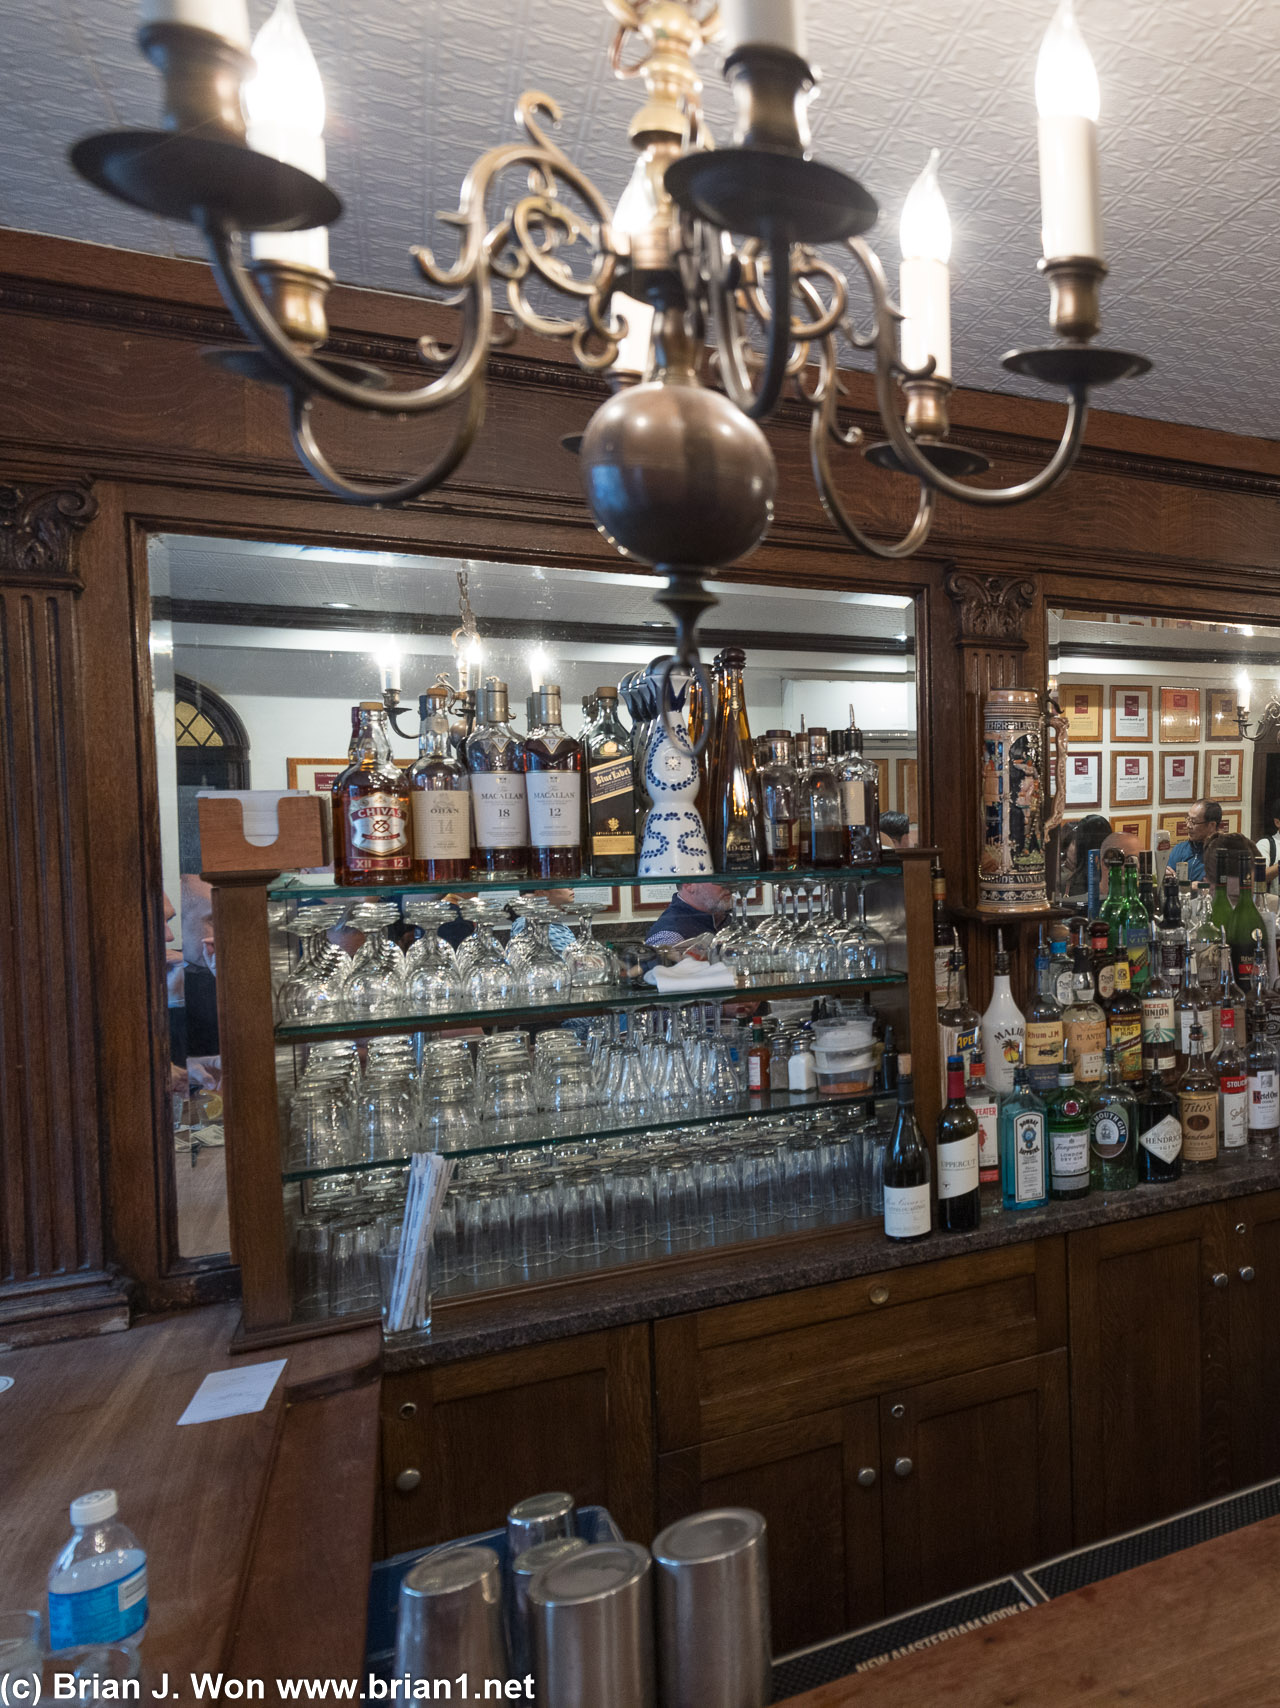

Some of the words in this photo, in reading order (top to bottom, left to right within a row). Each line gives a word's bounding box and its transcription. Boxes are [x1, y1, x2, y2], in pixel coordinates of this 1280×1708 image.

[594, 774, 612, 786] Blue
[612, 767, 631, 781] Label
[481, 792, 524, 800] MACALLAN
[357, 807, 402, 819] CHIVAS
[498, 808, 511, 818] 18
[548, 807, 562, 817] 12
[439, 819, 453, 834] 14
[356, 859, 372, 869] XII
[393, 858, 404, 868] 12
[1027, 1031, 1047, 1039] Rhum
[1184, 1101, 1213, 1113] Tito's
[1019, 1119, 1039, 1128] BOMBAY
[1117, 1120, 1127, 1135] GIN
[1018, 1145, 1041, 1156] SAPPHIRE
[1055, 1143, 1086, 1152] Tanqueray
[941, 1158, 977, 1169] UPPERCUT
